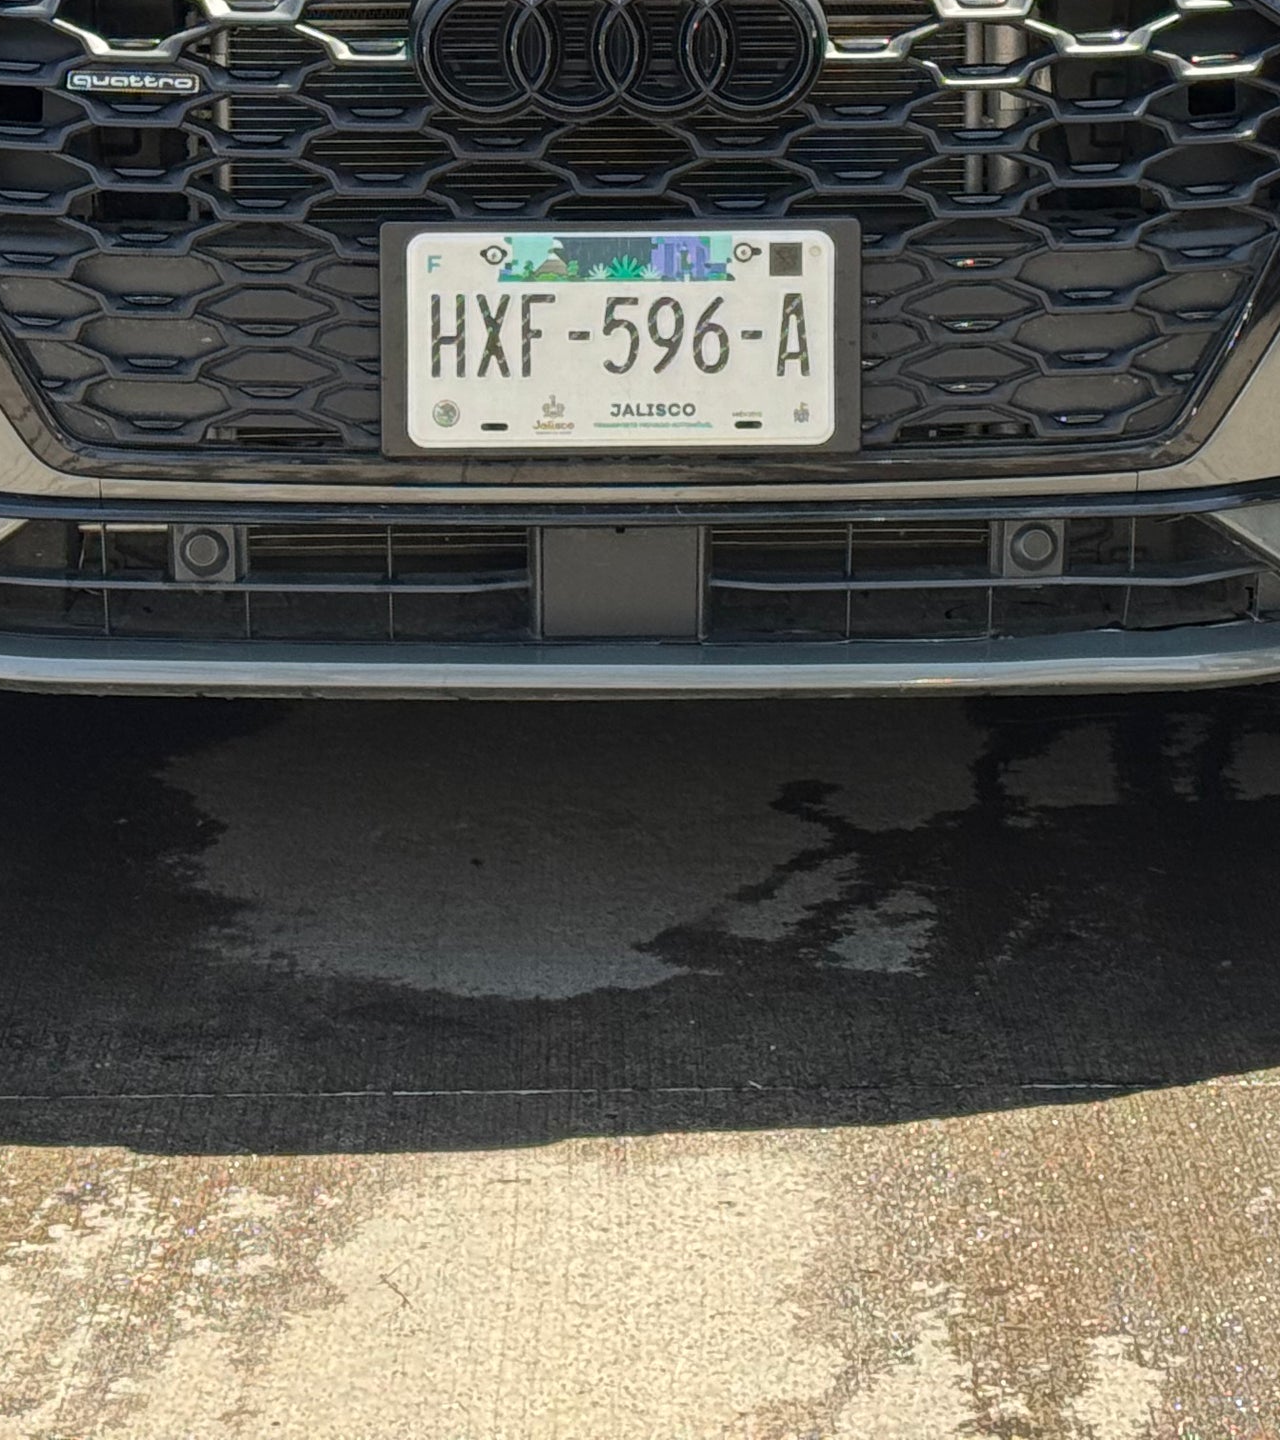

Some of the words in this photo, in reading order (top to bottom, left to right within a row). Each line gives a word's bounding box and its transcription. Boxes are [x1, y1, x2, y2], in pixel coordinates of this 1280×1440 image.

[72, 75, 193, 89] quattro
[427, 255, 442, 274] F
[430, 293, 811, 378] HXF-596-A
[610, 403, 697, 418] JALISCO
